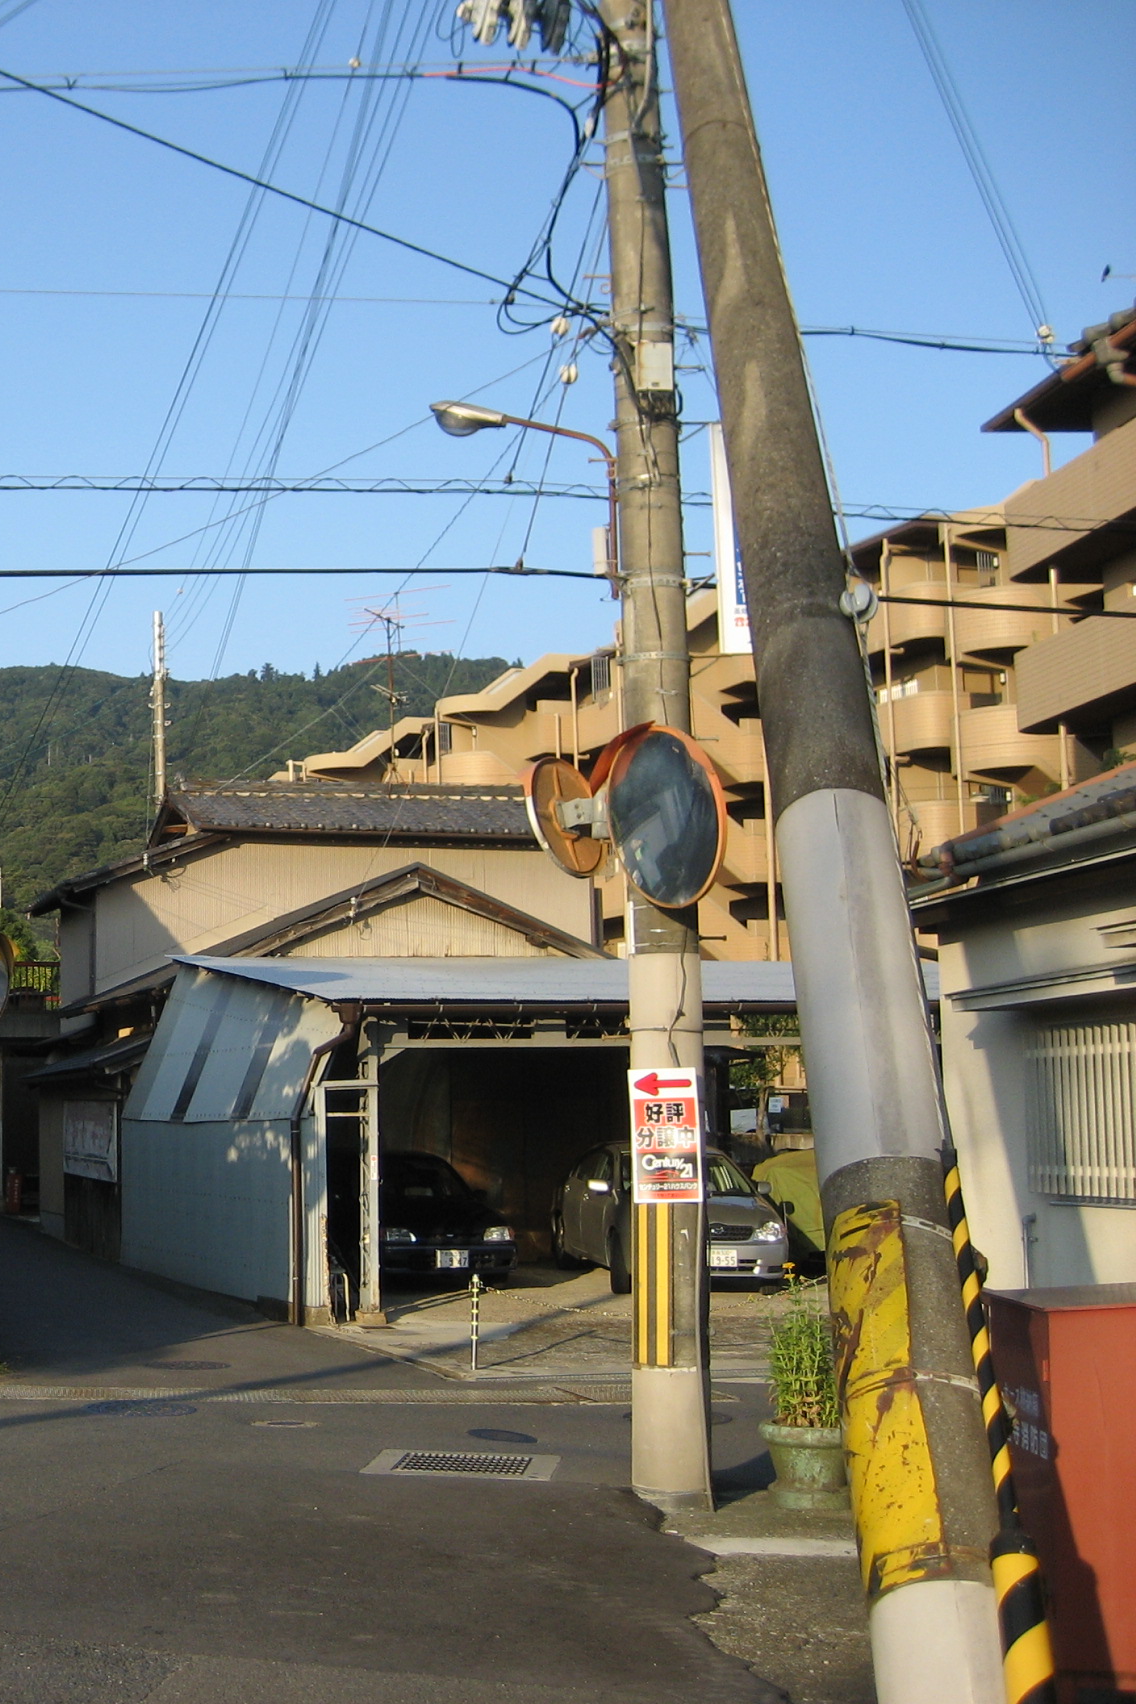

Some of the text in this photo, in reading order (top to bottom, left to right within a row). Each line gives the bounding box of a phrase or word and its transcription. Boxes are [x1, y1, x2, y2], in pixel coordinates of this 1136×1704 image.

[645, 1102, 685, 1124] 好評
[636, 1126, 697, 1150] 分譲中
[641, 1153, 694, 1178] Century 21
